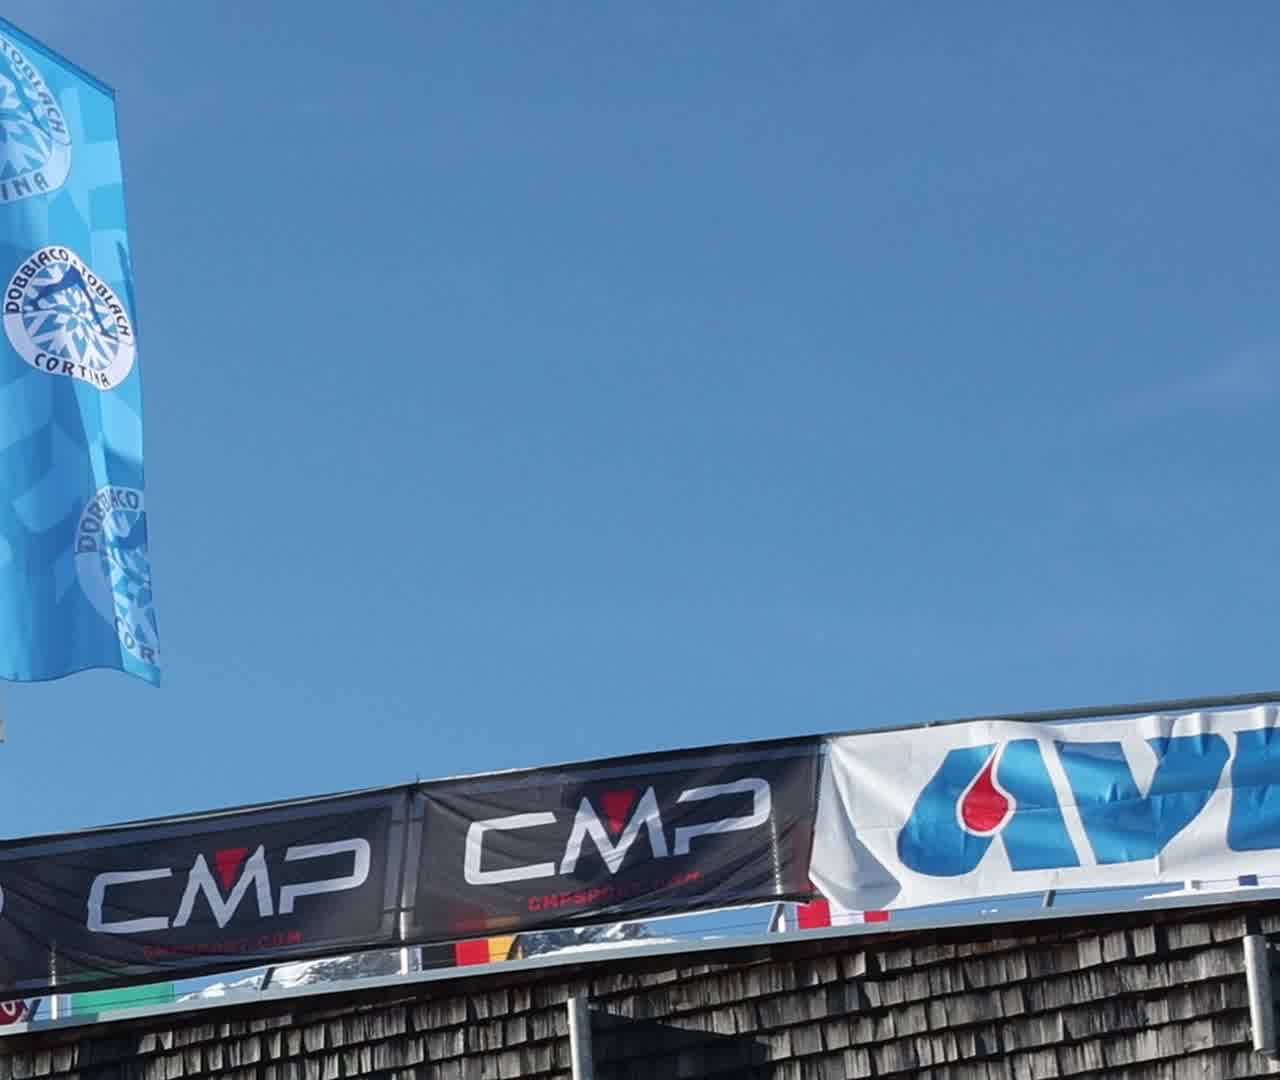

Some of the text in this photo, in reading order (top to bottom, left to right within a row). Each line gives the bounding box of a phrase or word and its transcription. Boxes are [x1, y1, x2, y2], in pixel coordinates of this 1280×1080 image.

[6, 248, 130, 336] DOBBIACO TOBLACH
[34, 353, 111, 388] CORTINA
[463, 778, 773, 885] CMP
[87, 837, 372, 934] CMP
